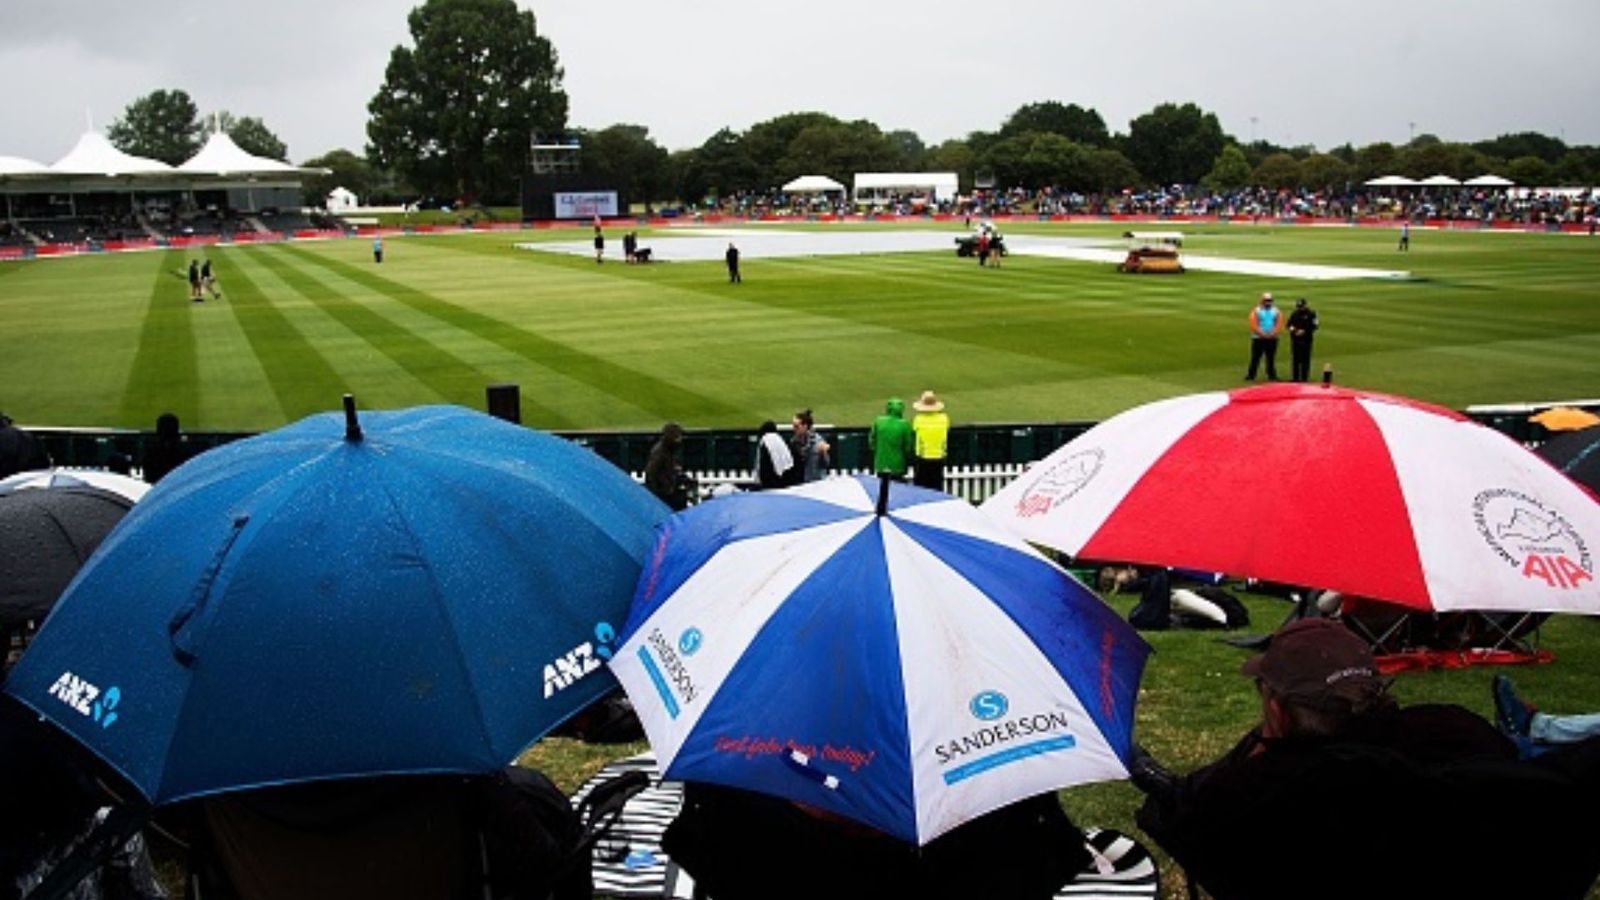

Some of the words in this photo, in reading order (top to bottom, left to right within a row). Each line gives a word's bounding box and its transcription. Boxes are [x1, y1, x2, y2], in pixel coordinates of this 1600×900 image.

[1522, 553, 1593, 589] AIA
[48, 670, 100, 716] ANZ
[543, 641, 601, 699] ANZ
[935, 712, 1068, 764] SANDERSON
